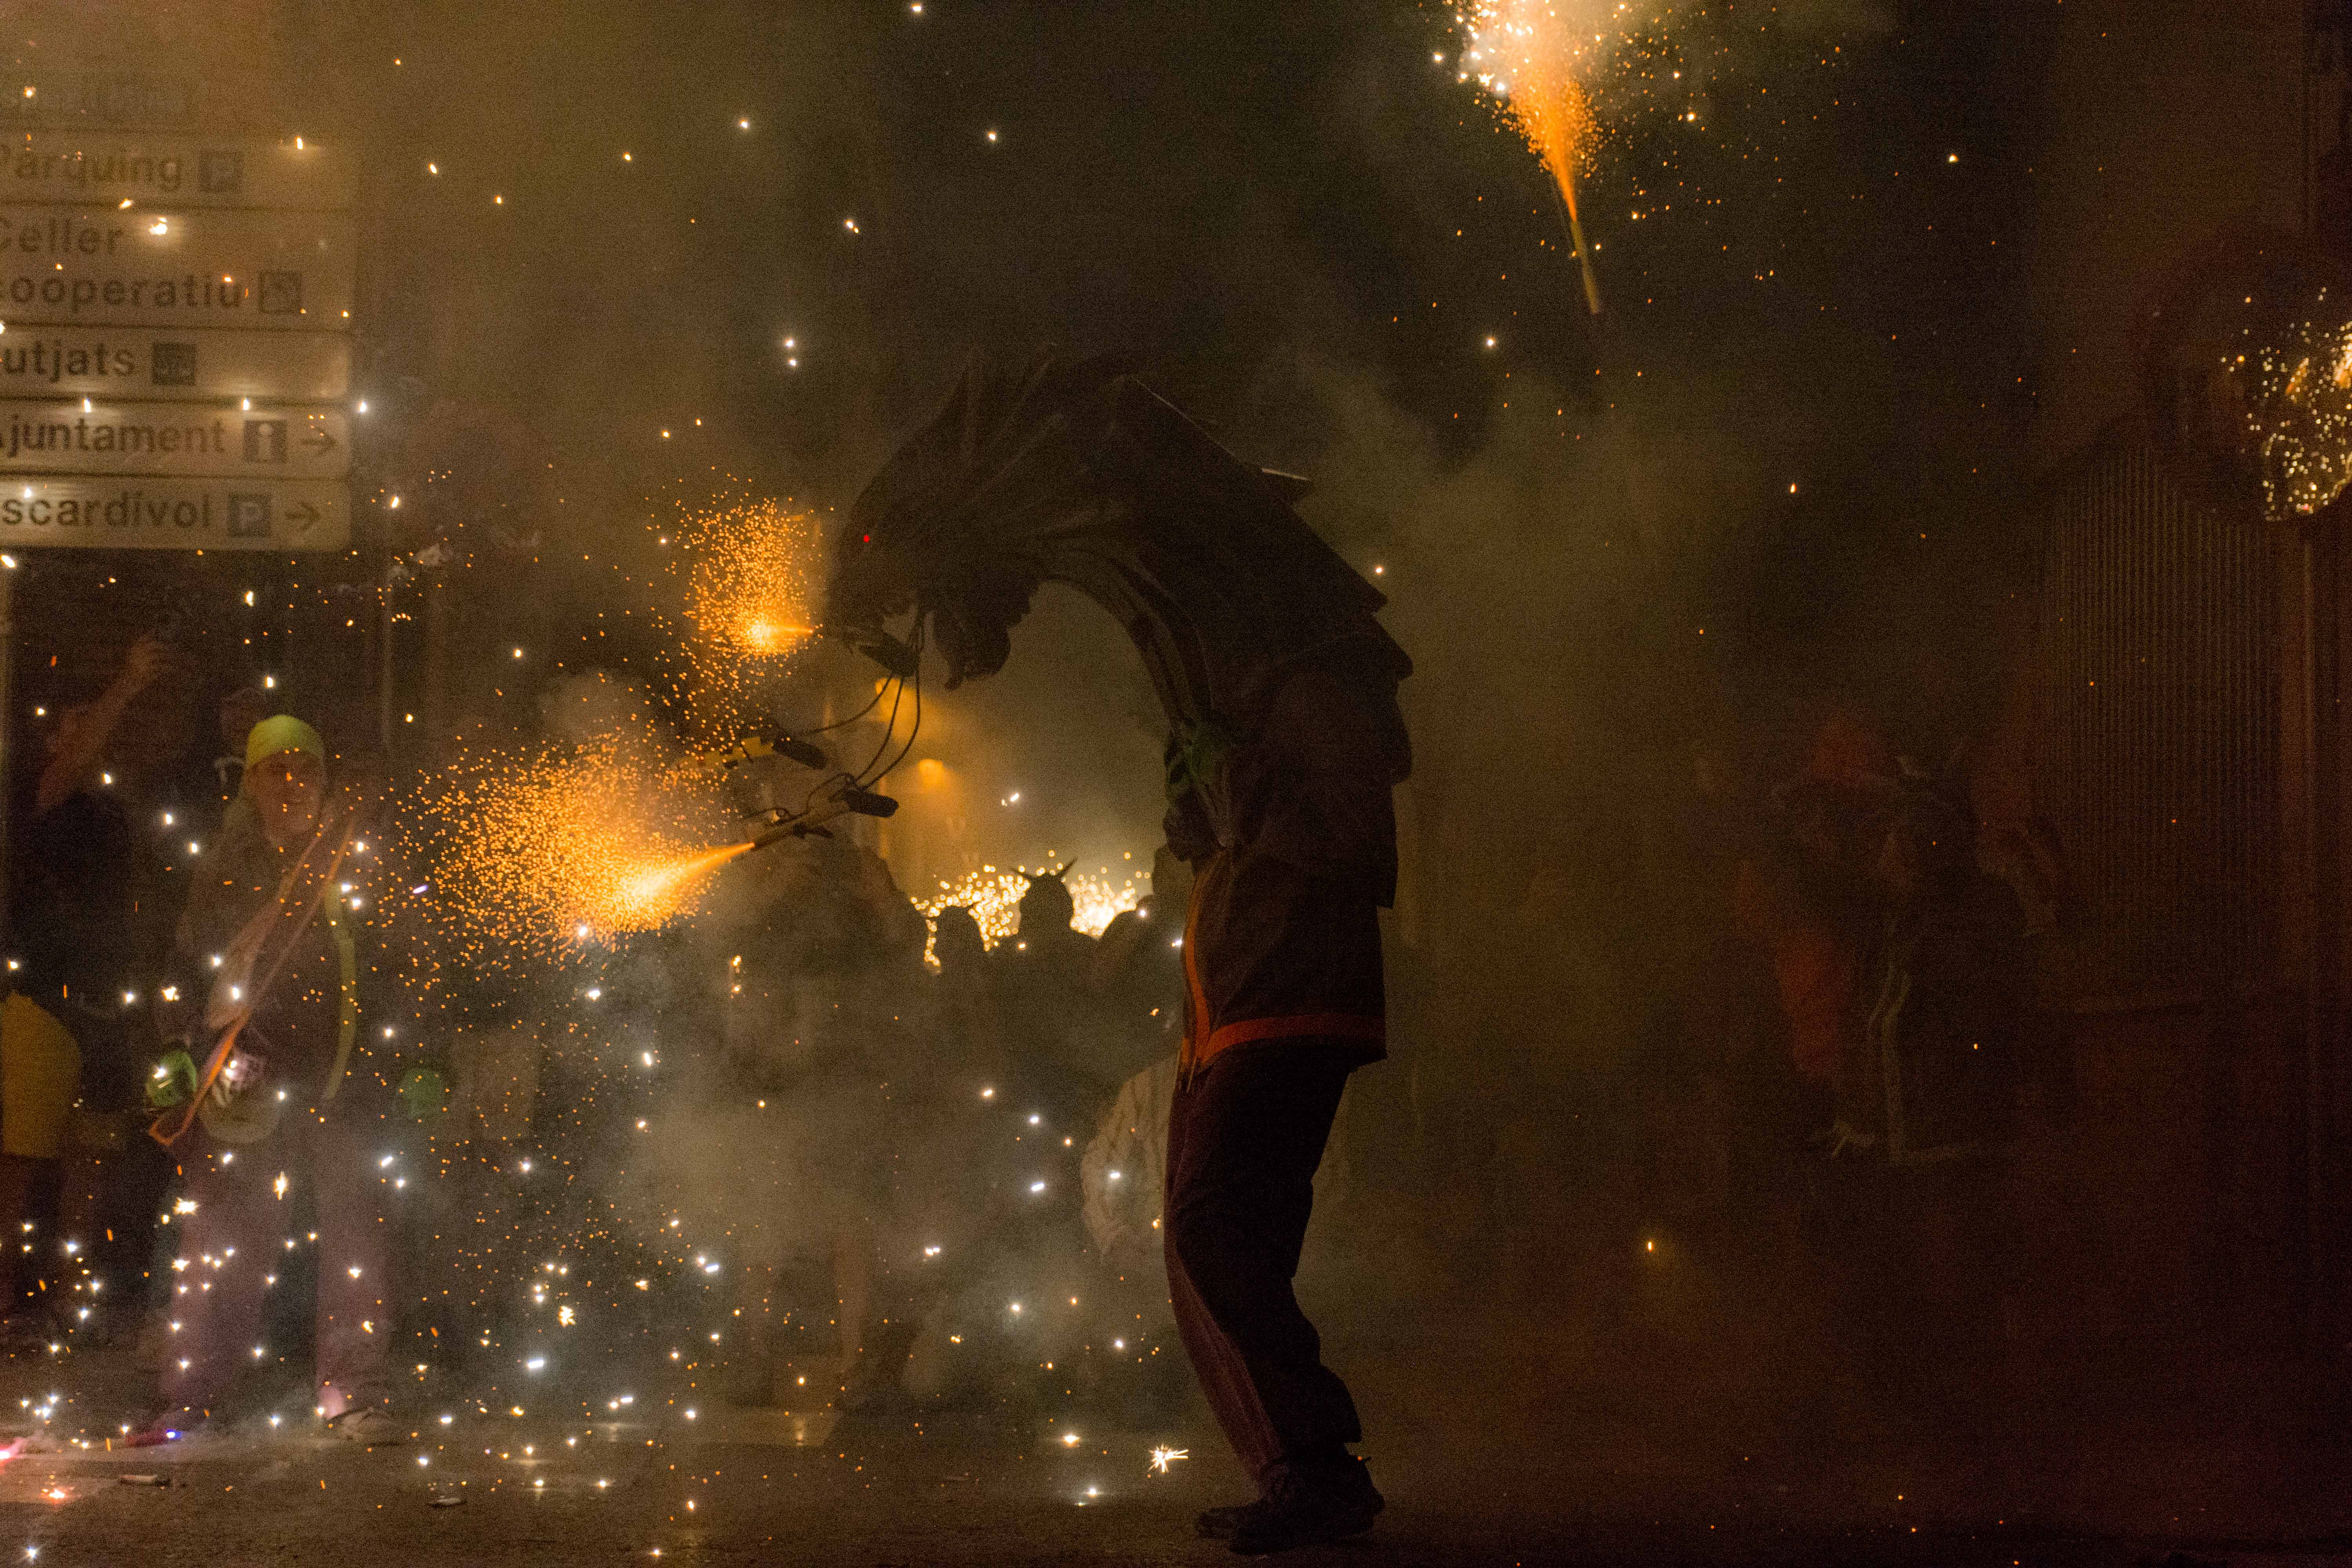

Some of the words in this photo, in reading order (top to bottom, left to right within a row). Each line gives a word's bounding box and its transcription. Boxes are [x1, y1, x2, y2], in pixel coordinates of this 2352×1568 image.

[0, 273, 242, 314] ooperatiu
[1, 339, 134, 383] utjats
[0, 413, 225, 457] juntament
